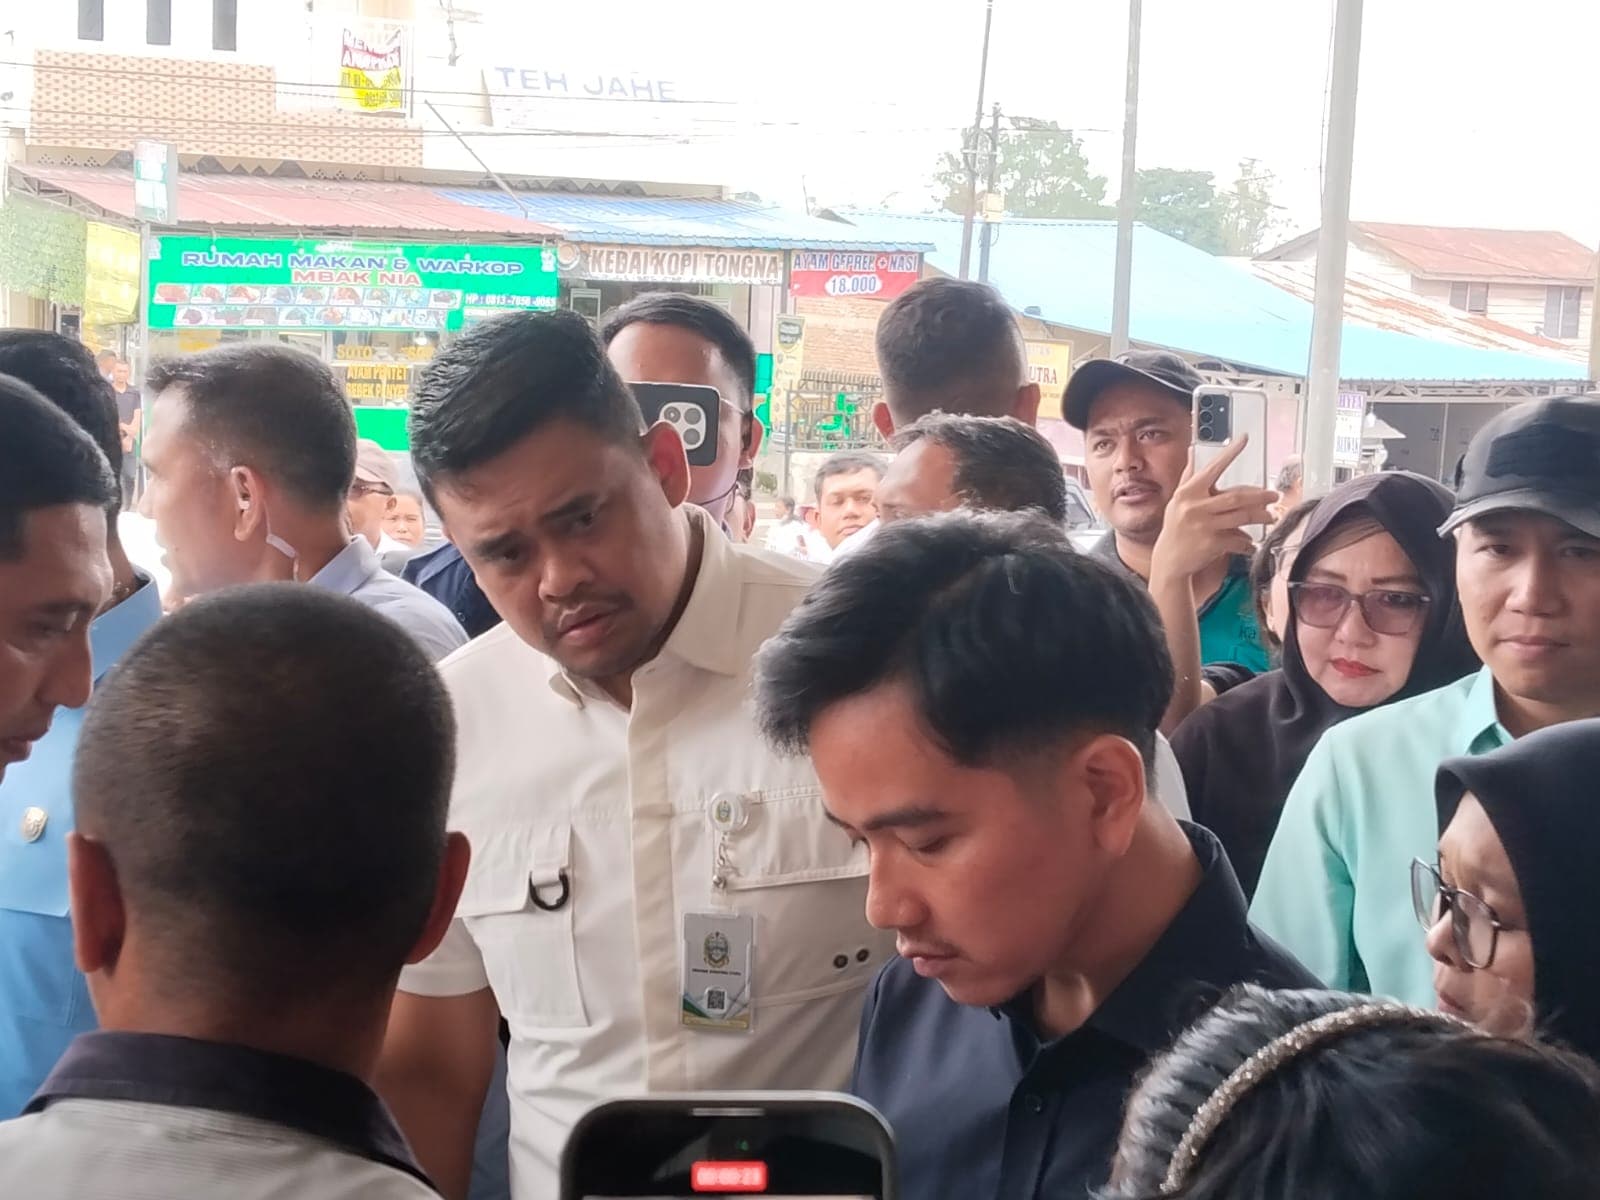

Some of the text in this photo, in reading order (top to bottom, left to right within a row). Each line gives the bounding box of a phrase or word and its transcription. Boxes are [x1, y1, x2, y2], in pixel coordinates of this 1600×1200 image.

[494, 66, 676, 102] TEH JAHE
[182, 253, 523, 275] RUMAH MAKAN & WARKOP
[653, 251, 698, 276] KOPI
[704, 253, 779, 279] TONGNA
[793, 253, 829, 269] AYAM
[889, 255, 918, 272] NASI
[293, 270, 421, 286] MBAK NIA
[831, 276, 877, 293] 18.000
[375, 383, 408, 400] PNYET
